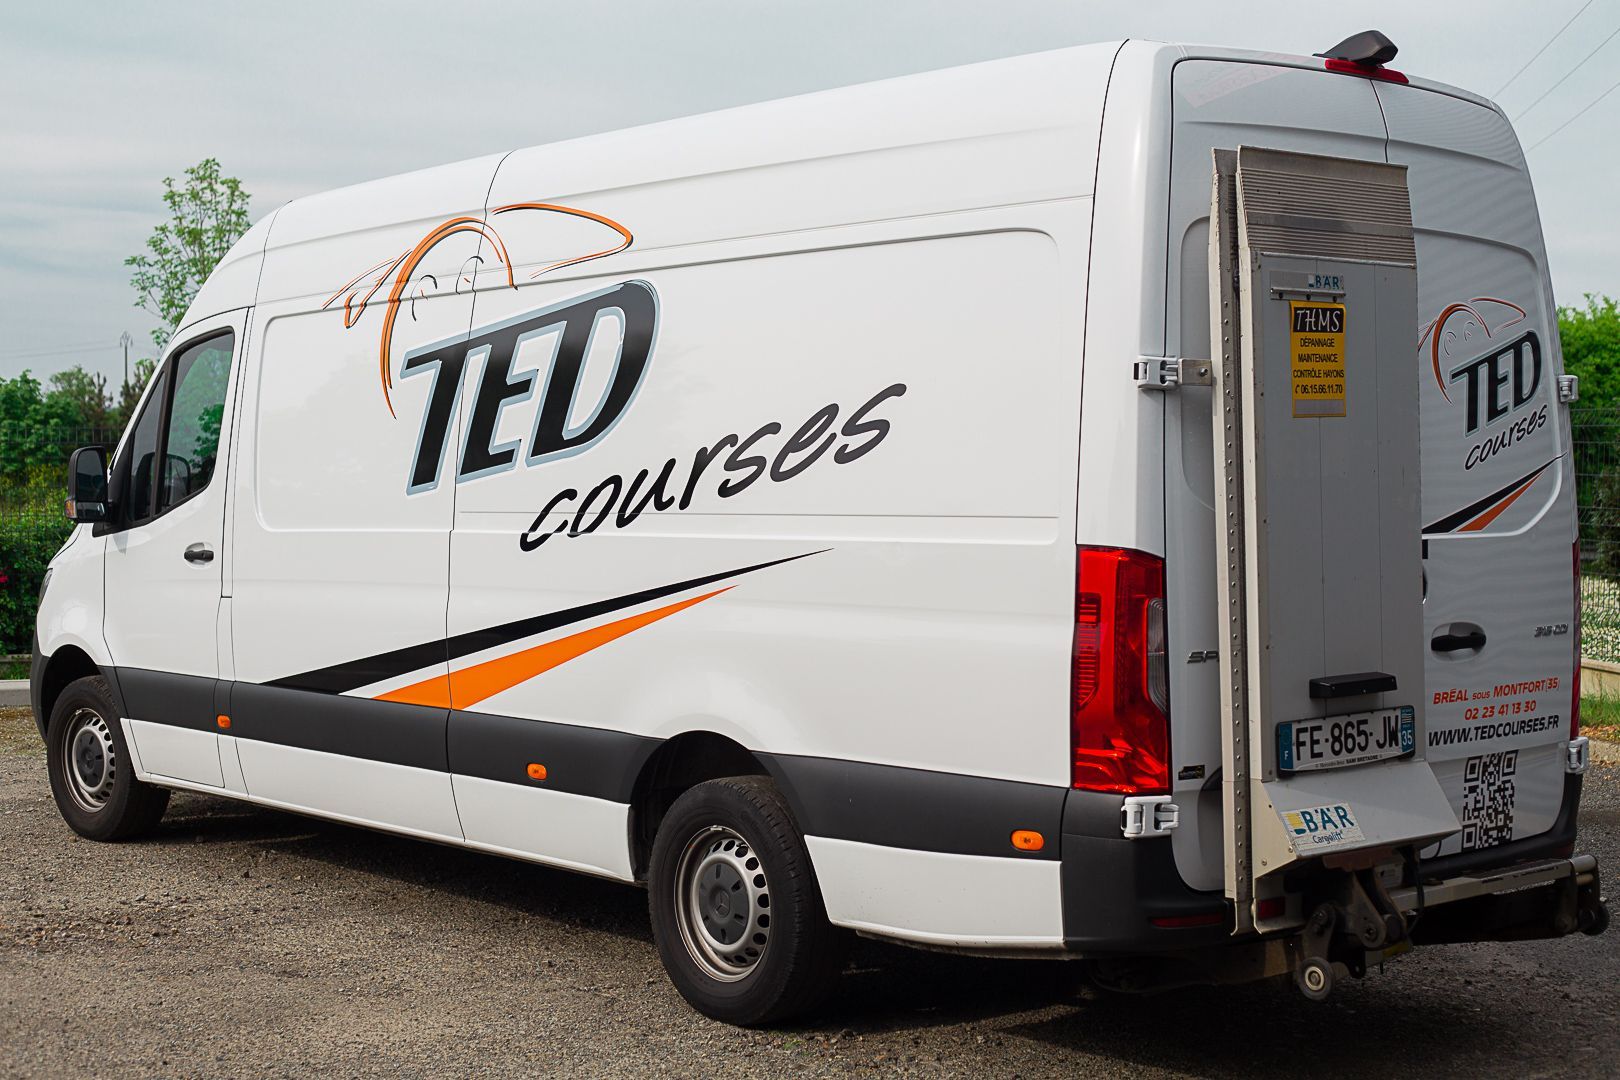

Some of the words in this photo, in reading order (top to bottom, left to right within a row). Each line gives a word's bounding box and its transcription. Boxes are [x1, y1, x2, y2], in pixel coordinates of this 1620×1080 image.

[1315, 274, 1339, 289] BÄR
[1296, 308, 1341, 332] THMS
[1300, 336, 1335, 347] DÉPANNAGE
[1298, 353, 1338, 363] MAINTENANCE
[1293, 367, 1322, 378] CONTRÔLE
[1322, 369, 1344, 378] HAYONS
[1450, 329, 1541, 437] TED
[400, 279, 660, 496] TED
[1465, 404, 1548, 470] courses
[520, 383, 908, 552] courses
[1433, 688, 1468, 704] BRÉAL
[1464, 707, 1479, 720] 02
[1482, 705, 1496, 719] 23
[1498, 703, 1509, 716] 41
[1511, 701, 1522, 714] 13
[1523, 699, 1537, 712] 30
[1401, 730, 1413, 746] 35
[1428, 714, 1560, 747] WWW.TEDCOURSES.FR
[1300, 805, 1355, 833] BÄR
